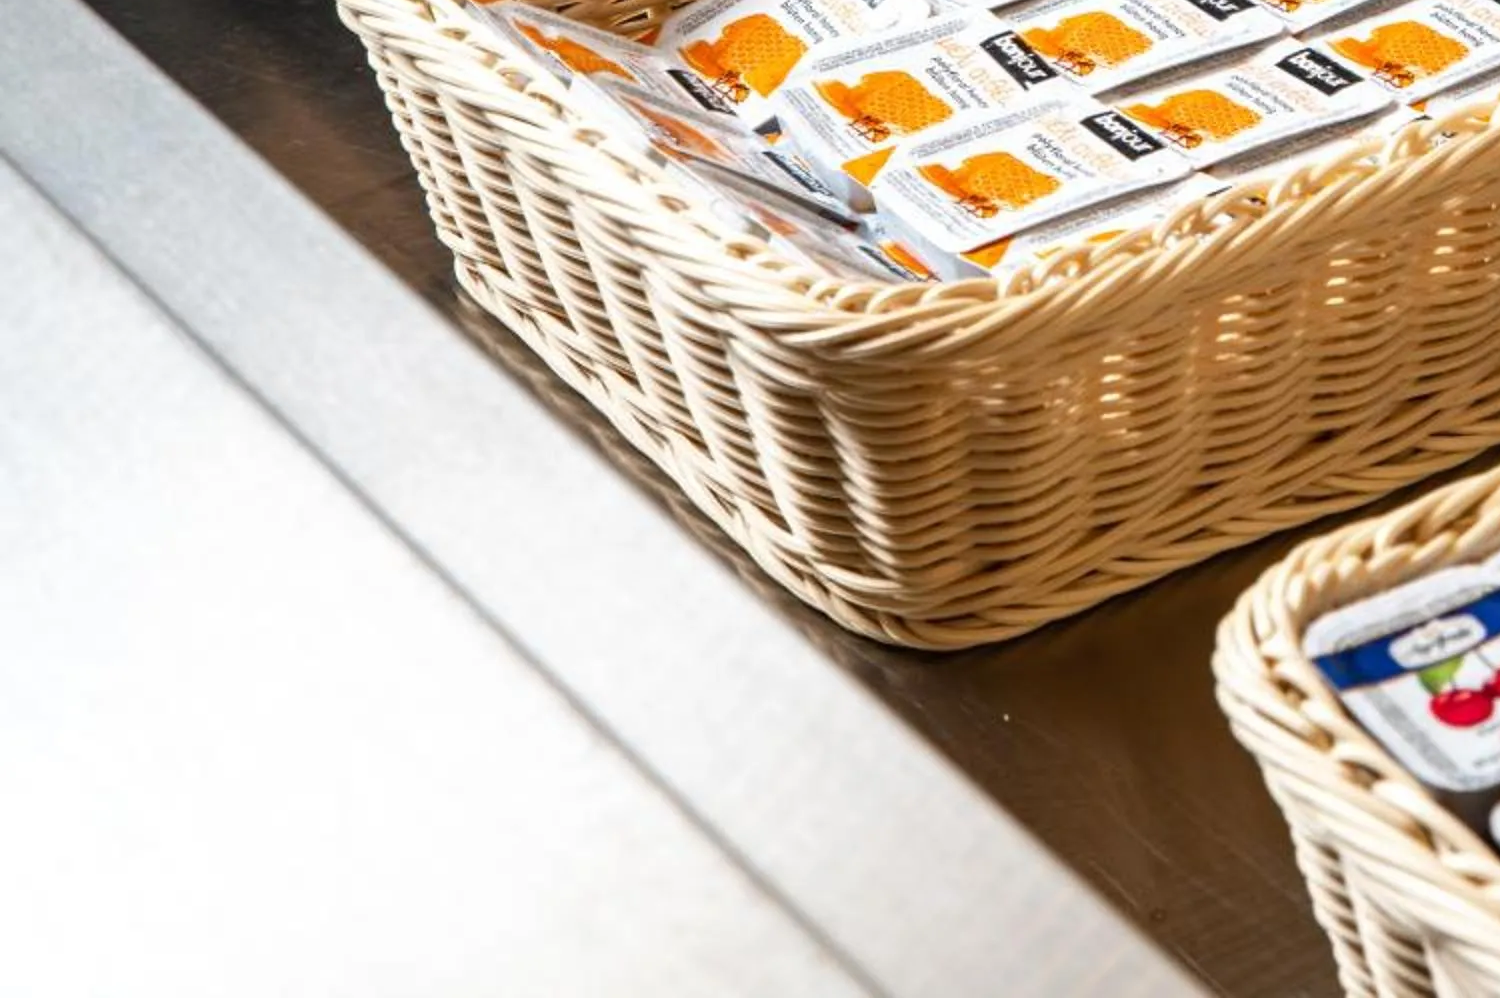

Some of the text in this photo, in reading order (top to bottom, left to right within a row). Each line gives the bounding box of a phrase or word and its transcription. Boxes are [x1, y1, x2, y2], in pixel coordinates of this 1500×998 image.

[995, 35, 1045, 80] bonjour
[1288, 51, 1350, 89] bonjour
[1093, 114, 1153, 152] bonjour
